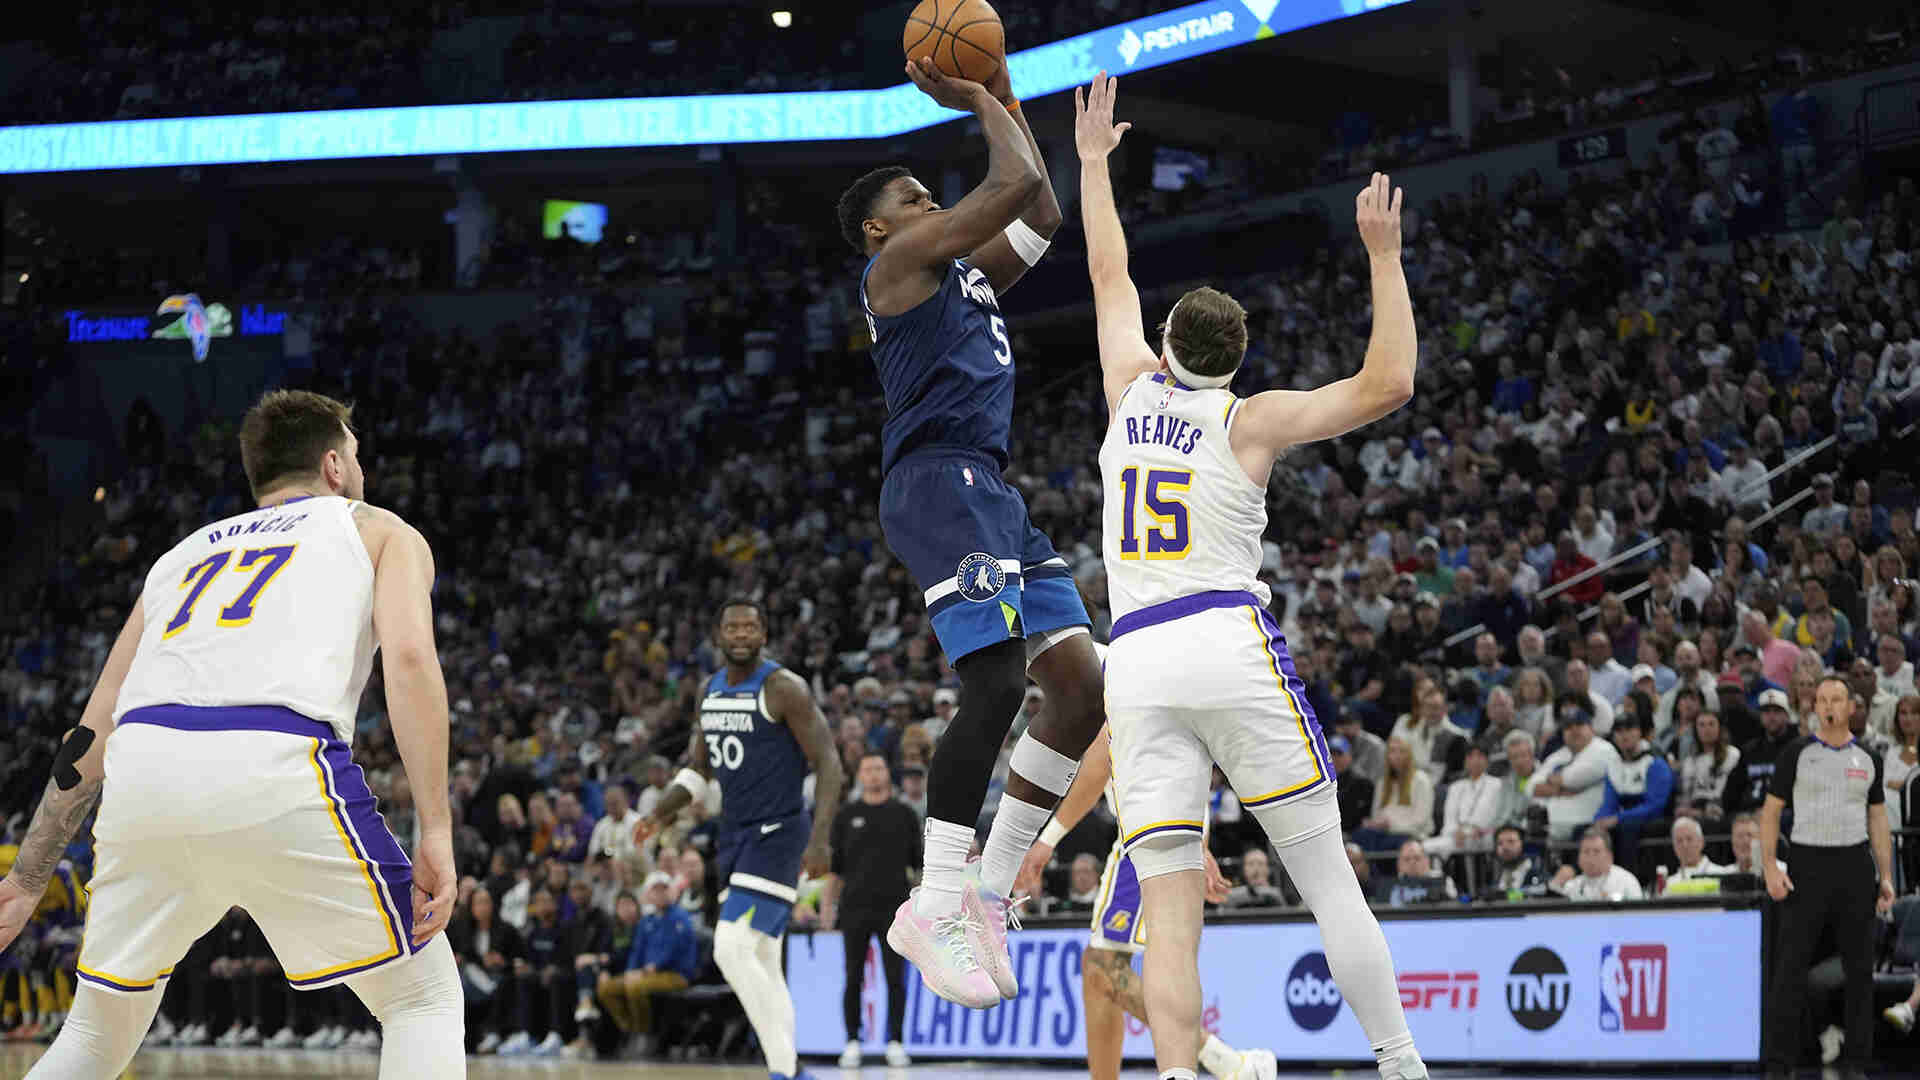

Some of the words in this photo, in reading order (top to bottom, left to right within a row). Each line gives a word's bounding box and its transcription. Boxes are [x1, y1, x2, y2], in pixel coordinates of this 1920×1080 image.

[1143, 11, 1234, 52] PENTAIR
[0, 122, 184, 171] SUSTAINABLY
[413, 108, 472, 152] AND
[479, 104, 571, 149] ENJOY
[787, 94, 867, 138] MOST
[990, 314, 1012, 366] 5
[1126, 415, 1202, 454] REAVES
[1120, 464, 1194, 561] 15
[161, 541, 299, 641] 77
[705, 733, 745, 770] 30
[1288, 971, 1341, 1006] abc
[1399, 972, 1479, 1009] SPN
[1506, 974, 1571, 1011] TNT
[1627, 958, 1663, 1018] TV
